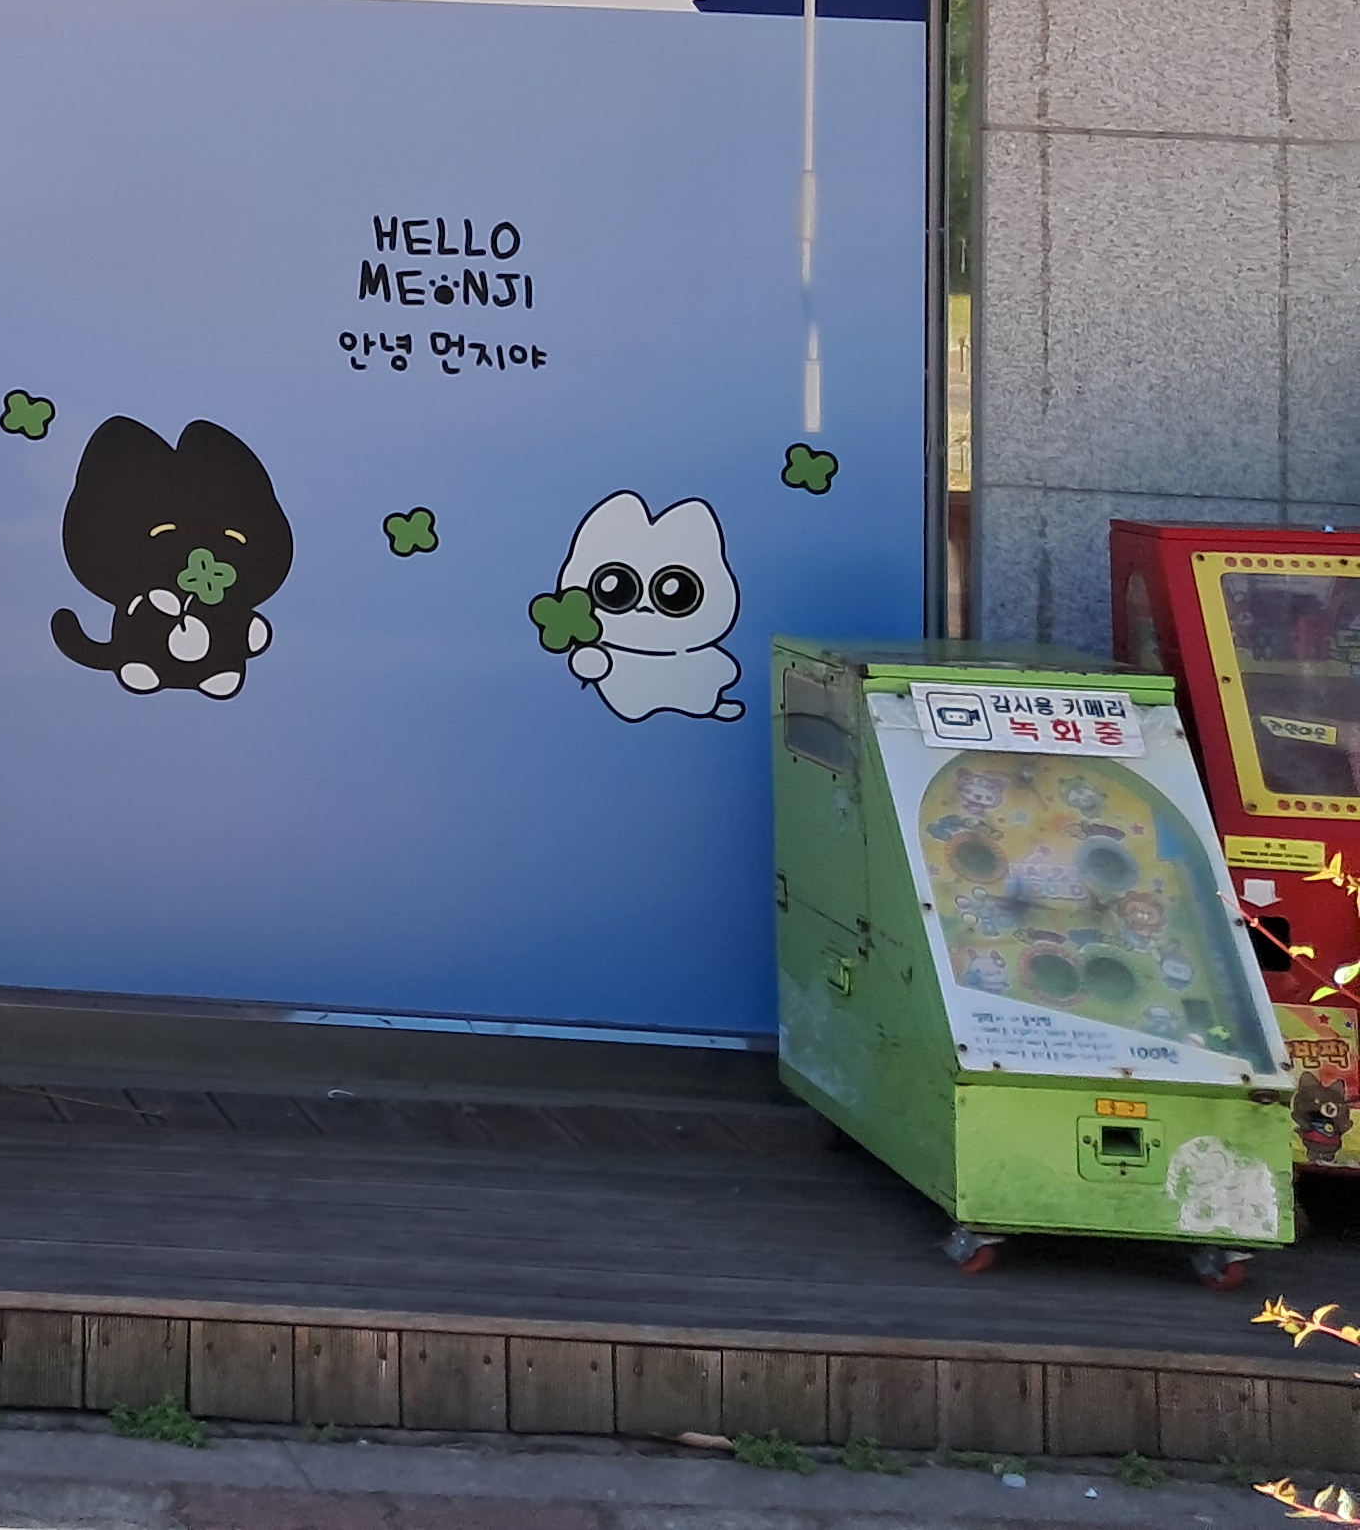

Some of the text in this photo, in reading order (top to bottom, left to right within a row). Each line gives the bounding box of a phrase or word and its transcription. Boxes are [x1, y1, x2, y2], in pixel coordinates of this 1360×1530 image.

[373, 215, 521, 260] HELLO
[339, 332, 548, 375] 안녕 먼지야
[990, 694, 1055, 717] 감시용
